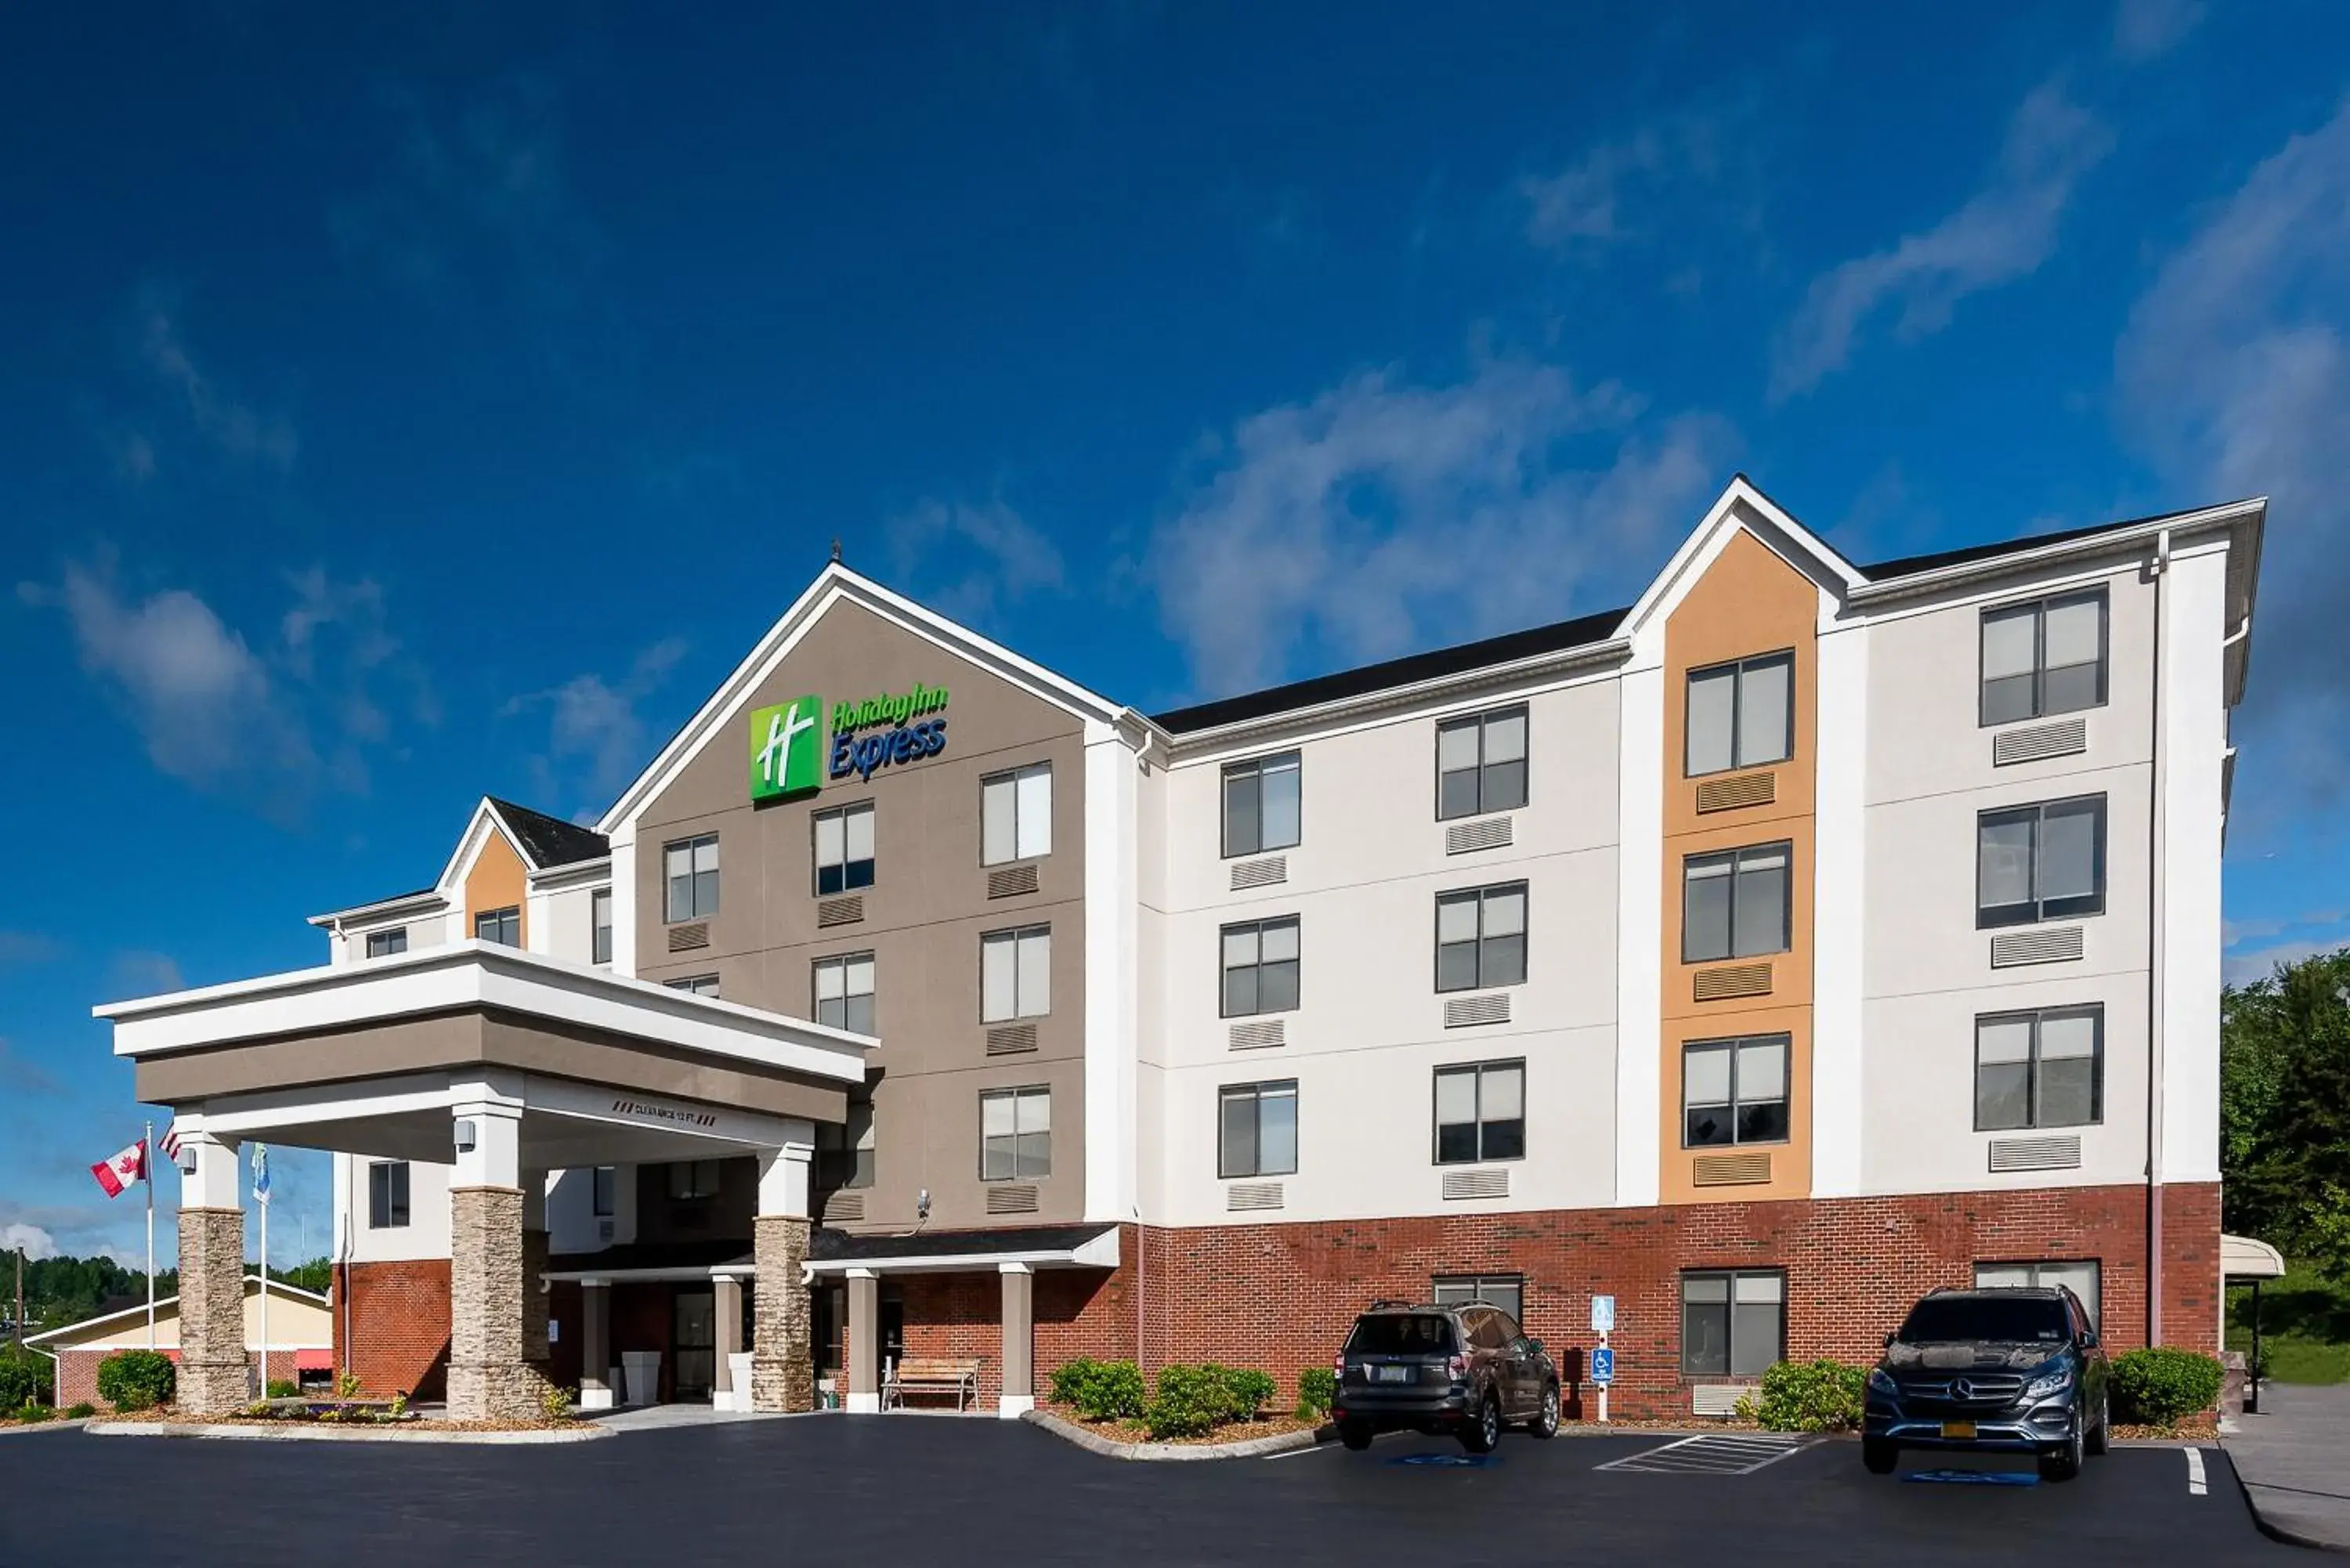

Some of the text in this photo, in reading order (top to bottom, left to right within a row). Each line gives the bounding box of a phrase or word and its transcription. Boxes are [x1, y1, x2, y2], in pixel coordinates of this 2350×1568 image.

[830, 682, 949, 732] Holiday Inn
[829, 718, 947, 780] Express
